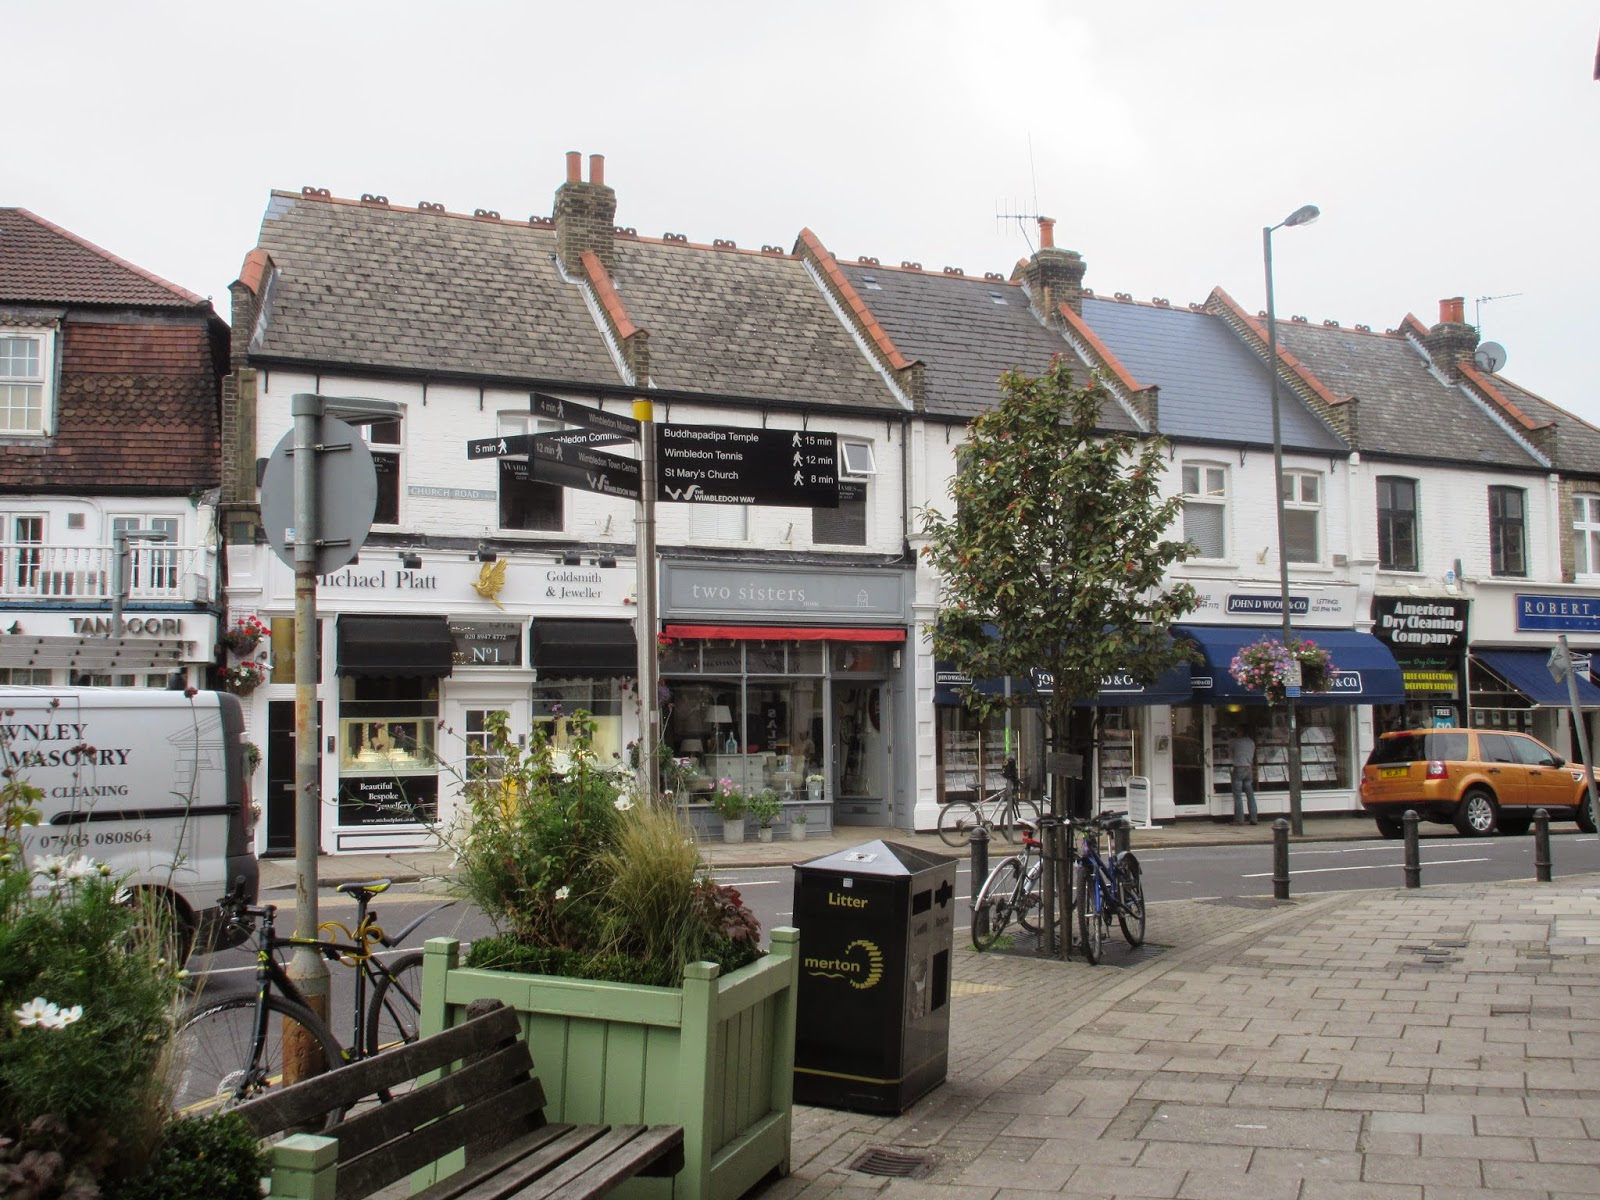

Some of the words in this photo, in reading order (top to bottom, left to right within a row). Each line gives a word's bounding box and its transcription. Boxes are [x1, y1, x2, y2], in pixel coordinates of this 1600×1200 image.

[546, 402, 557, 412] min
[588, 413, 617, 429] Wimbledon
[616, 420, 637, 433] Museum
[550, 434, 587, 444] mbledon
[589, 432, 622, 442] Commo
[664, 428, 726, 441] Buddhapadipa
[728, 432, 760, 443] Temple
[805, 436, 815, 446] 15
[817, 437, 832, 446] min
[475, 445, 481, 453] 5
[482, 444, 496, 453] min
[536, 442, 544, 453] 12
[544, 444, 555, 455] min
[664, 447, 713, 459] Wimbledon
[715, 450, 743, 461] Tennis
[805, 455, 816, 464] 12
[818, 456, 833, 465] min
[578, 451, 607, 467] Wimbledon
[607, 458, 621, 470] Town
[621, 462, 638, 474] Centre
[664, 467, 675, 477] St
[677, 468, 706, 480] Mary's
[707, 470, 739, 480] Church
[811, 474, 817, 483] 8
[818, 475, 834, 484] min
[411, 487, 450, 497] CHURCH
[454, 489, 479, 498] ROAD
[694, 494, 739, 503] WIMBLEDON
[739, 495, 755, 503] WAY
[395, 570, 438, 589] Platt
[546, 570, 602, 583] Goldsmith
[546, 585, 556, 597] &
[559, 586, 603, 599] Jeweller
[692, 583, 731, 599] two
[739, 582, 806, 602] sisters
[1230, 599, 1254, 610] JOHN
[1255, 599, 1262, 609] D
[1393, 601, 1455, 616] American
[1524, 601, 1590, 615] ROBERT
[69, 616, 183, 635] TANOORI
[1383, 615, 1407, 630] Dry
[1407, 615, 1464, 632] Cleaning
[1391, 629, 1455, 646] Company
[1335, 677, 1343, 688] &
[1403, 672, 1417, 680] FREE
[1417, 672, 1454, 680] COLLECTION
[1436, 708, 1450, 716] FREE
[9, 748, 132, 767] MASONRY
[52, 784, 129, 799] CLEANING
[360, 781, 393, 791] Beautiful
[368, 792, 399, 802] Bespoke
[95, 828, 152, 846] 080864
[828, 891, 869, 909] Litter
[804, 956, 861, 973] merton
